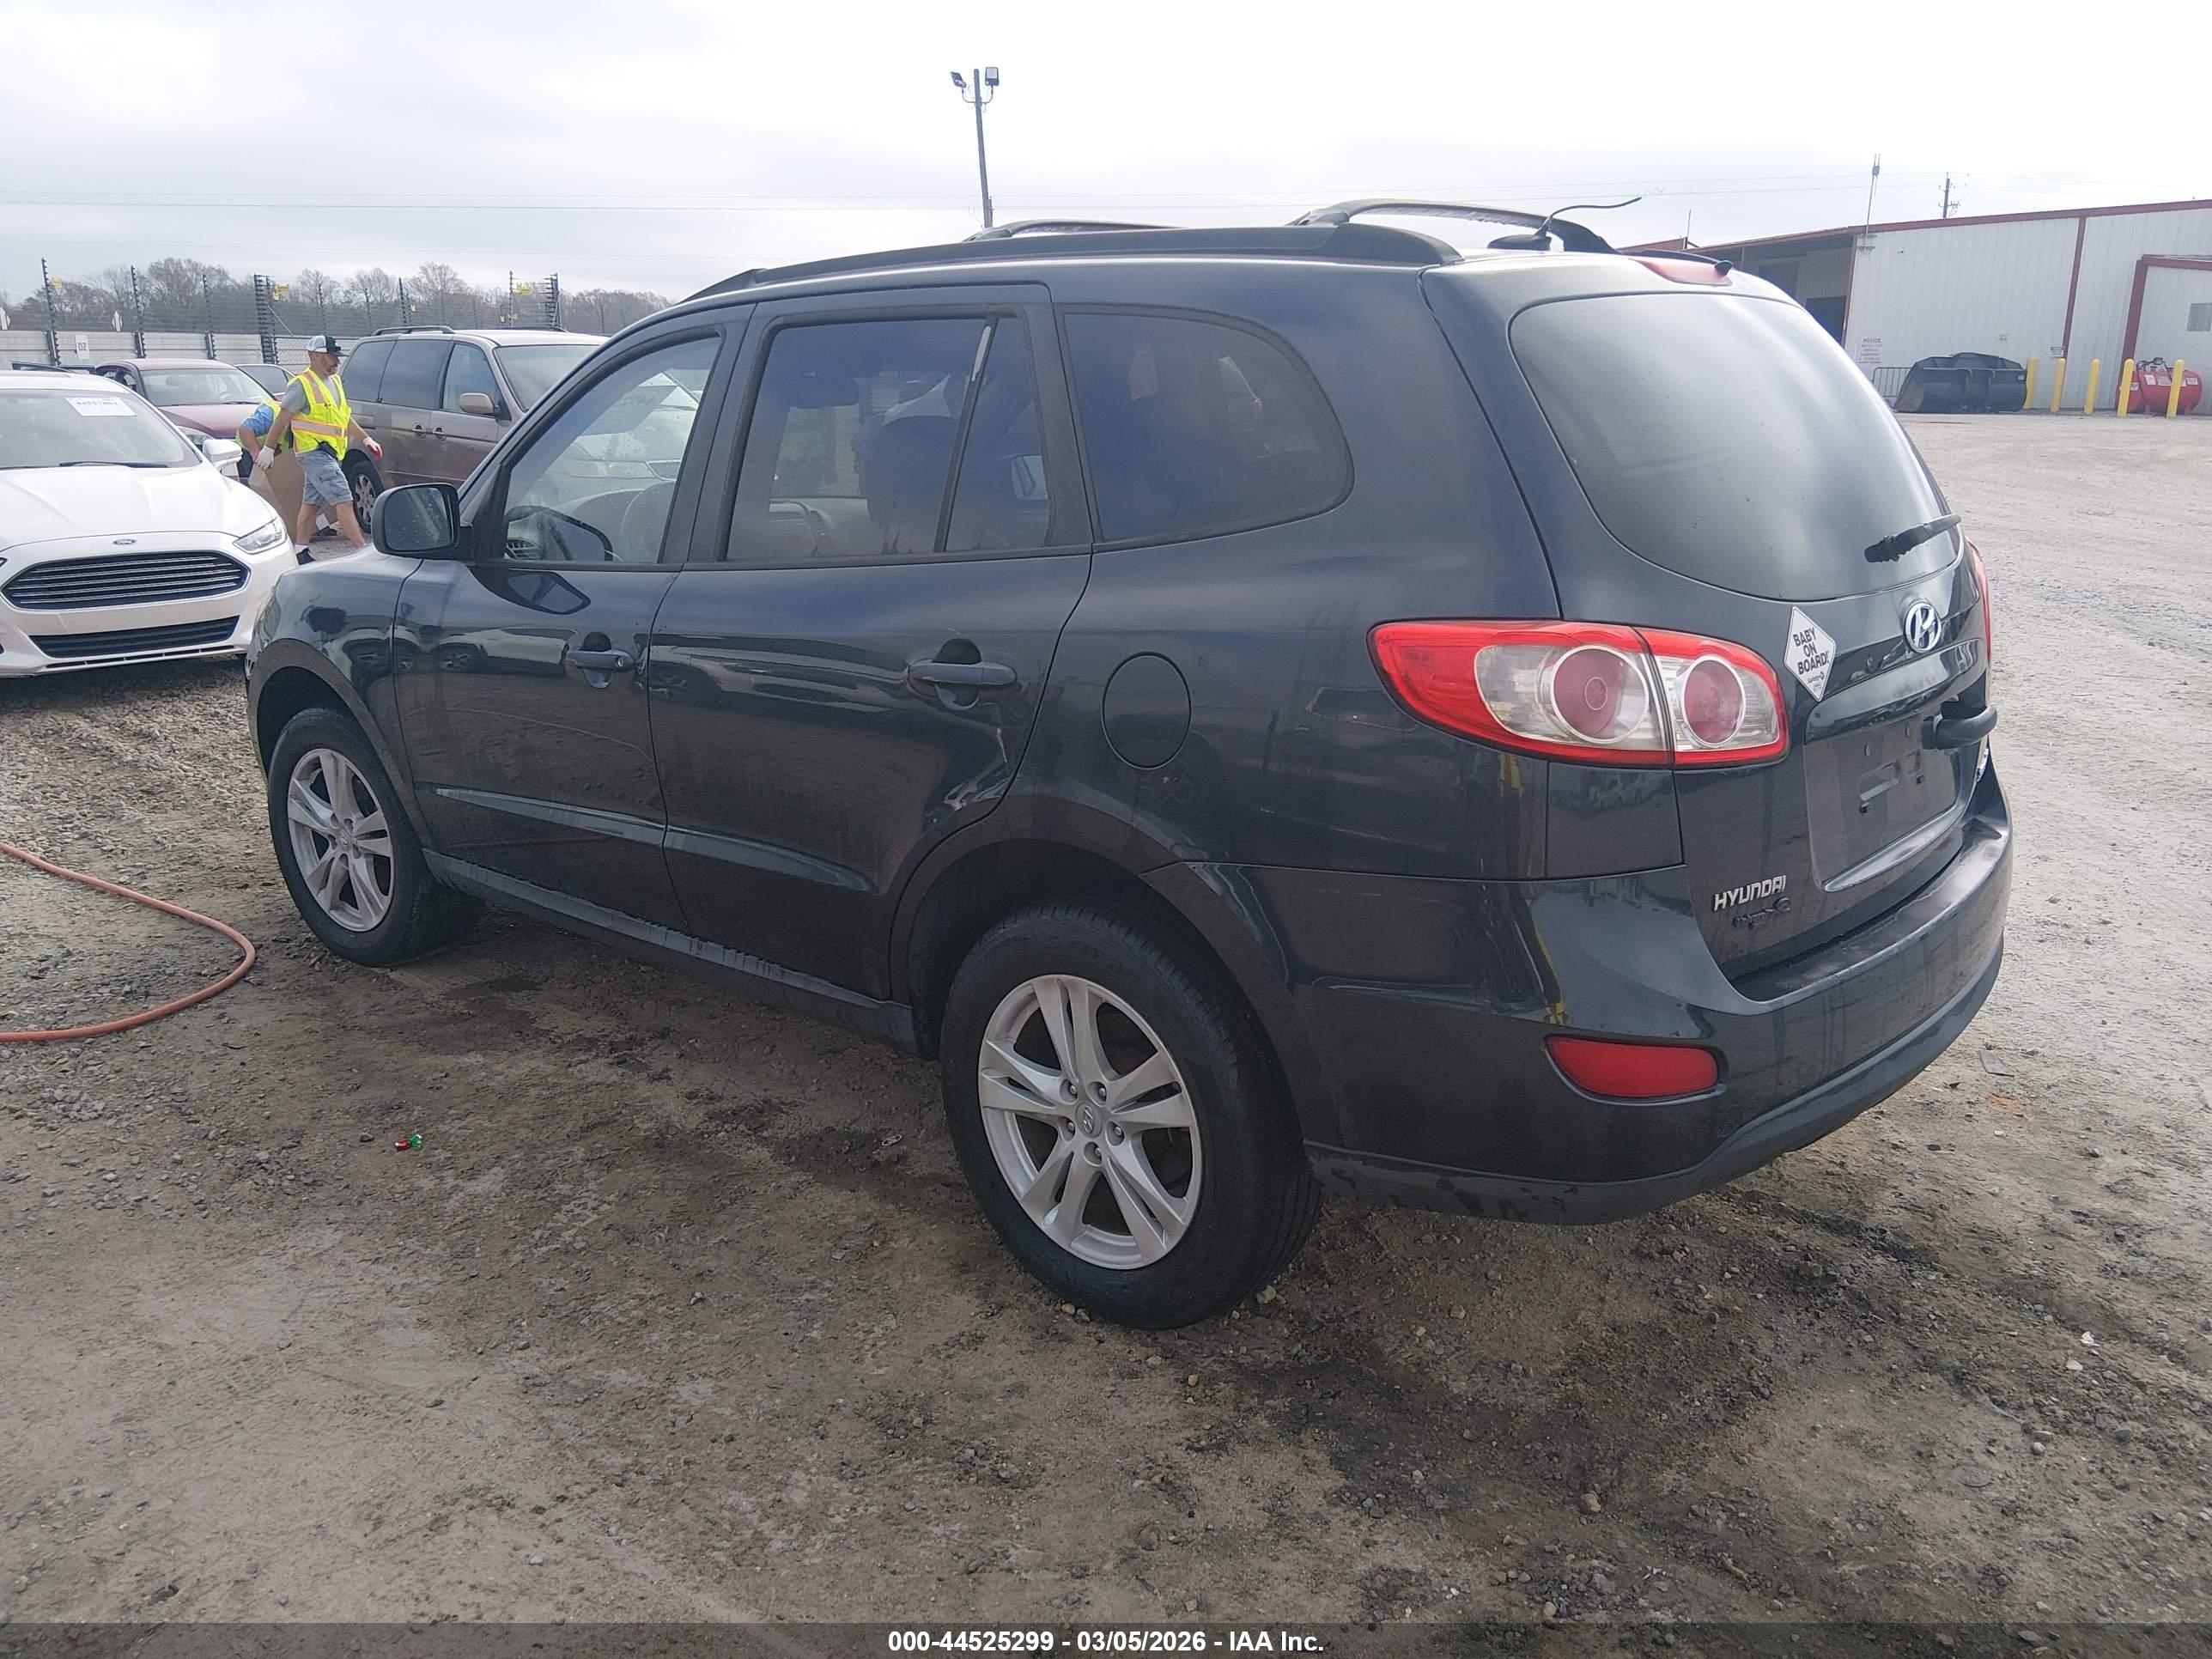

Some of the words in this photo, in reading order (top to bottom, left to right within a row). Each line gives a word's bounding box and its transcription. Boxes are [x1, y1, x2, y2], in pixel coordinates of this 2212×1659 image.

[1792, 627, 1816, 647] BABY
[1803, 641, 1818, 658] ON
[1797, 650, 1830, 676] BOARD!
[1712, 874, 1787, 912] HYUNDAI
